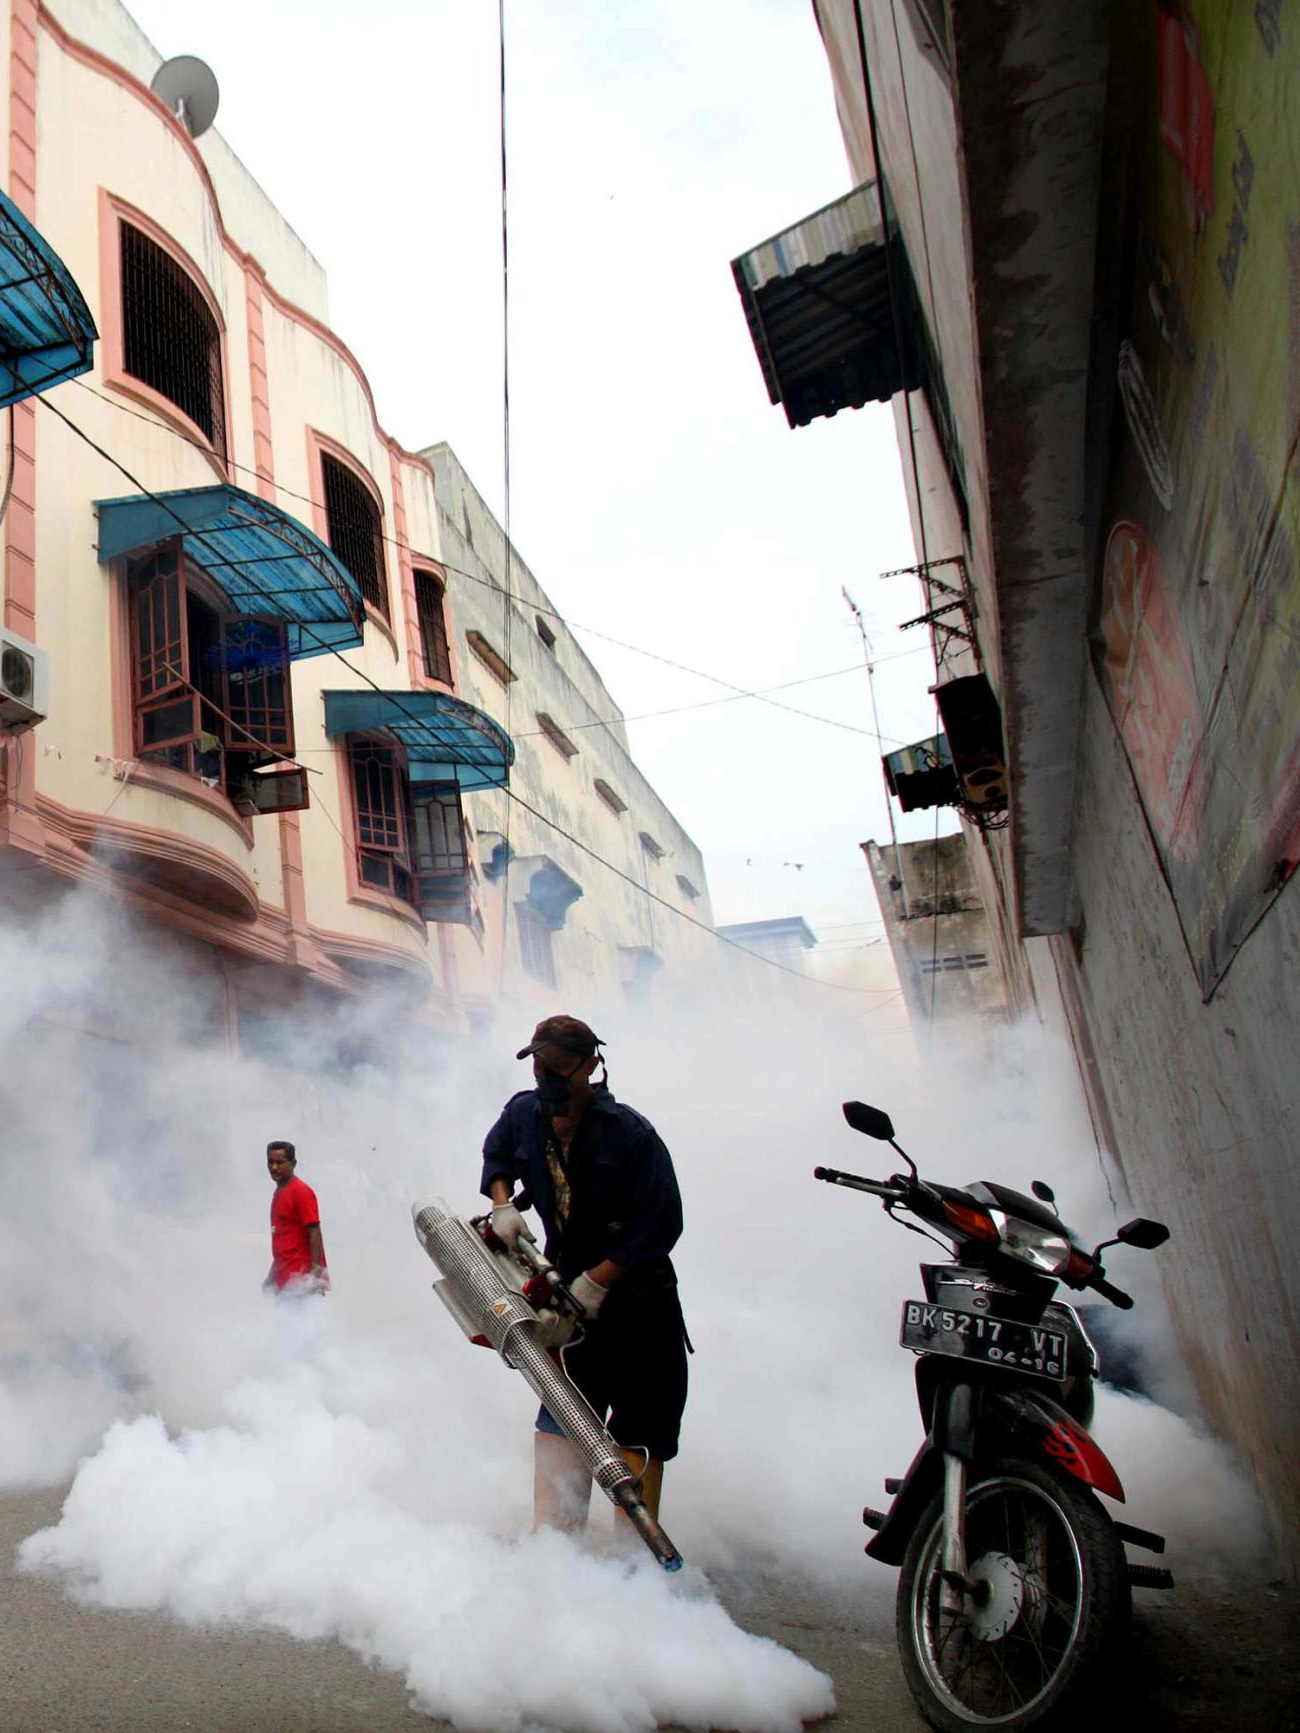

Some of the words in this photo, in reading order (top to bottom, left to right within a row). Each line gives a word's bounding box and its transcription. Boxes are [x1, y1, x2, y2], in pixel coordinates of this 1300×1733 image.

[907, 1304, 936, 1329] BK
[941, 1311, 1002, 1342] 5217
[1033, 1330, 1062, 1356] VT
[988, 1347, 1060, 1374] 04-16
